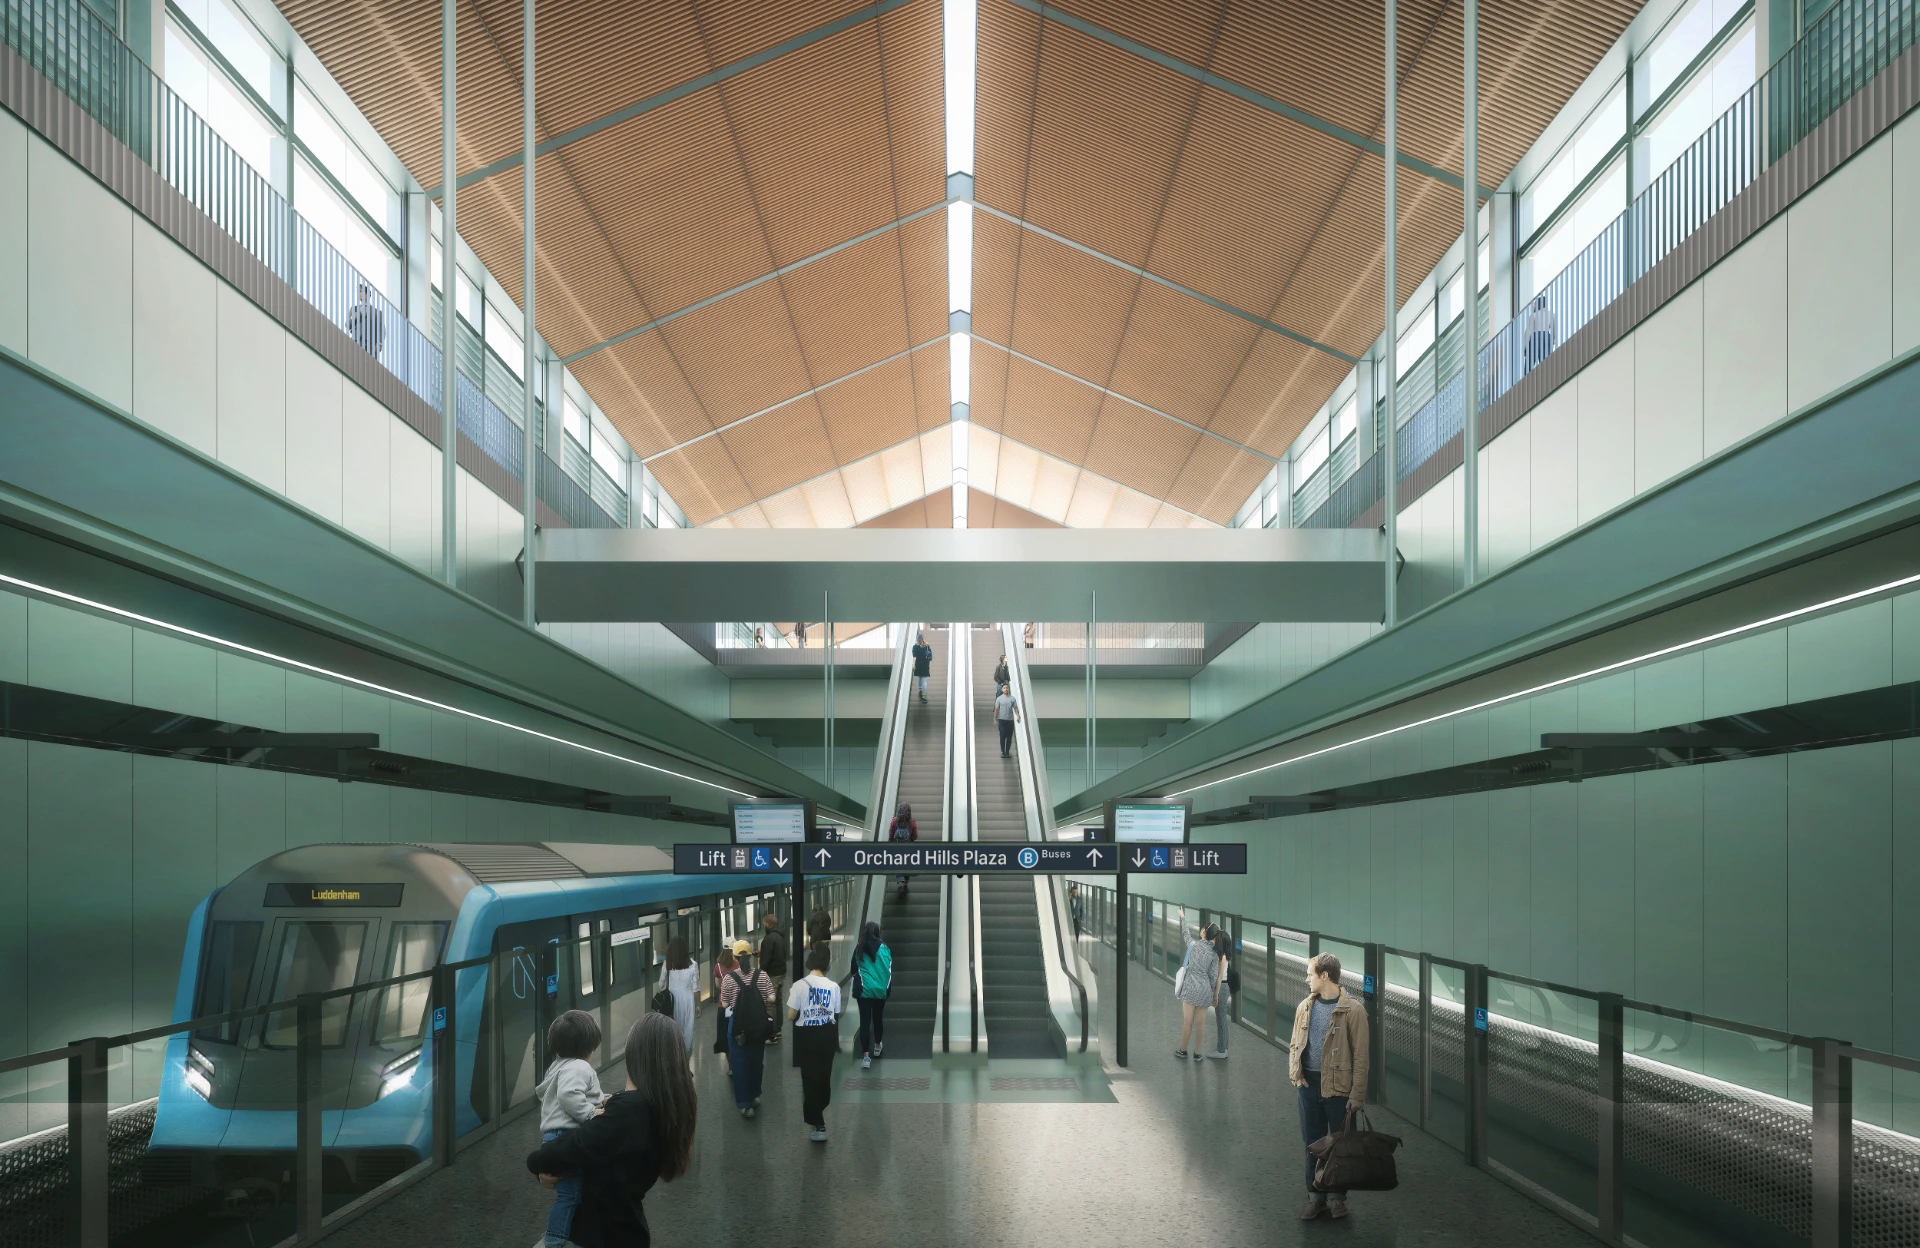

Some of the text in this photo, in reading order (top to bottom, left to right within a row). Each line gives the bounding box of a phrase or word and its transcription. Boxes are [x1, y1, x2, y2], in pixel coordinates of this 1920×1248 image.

[825, 831, 832, 840] 2
[1090, 831, 1096, 840] 1
[699, 850, 726, 867] Lift
[854, 849, 1007, 866] Orchard Hills Plaza
[1041, 849, 1071, 859] Buses
[1193, 850, 1220, 866] Lift
[311, 889, 361, 900] Luddenham
